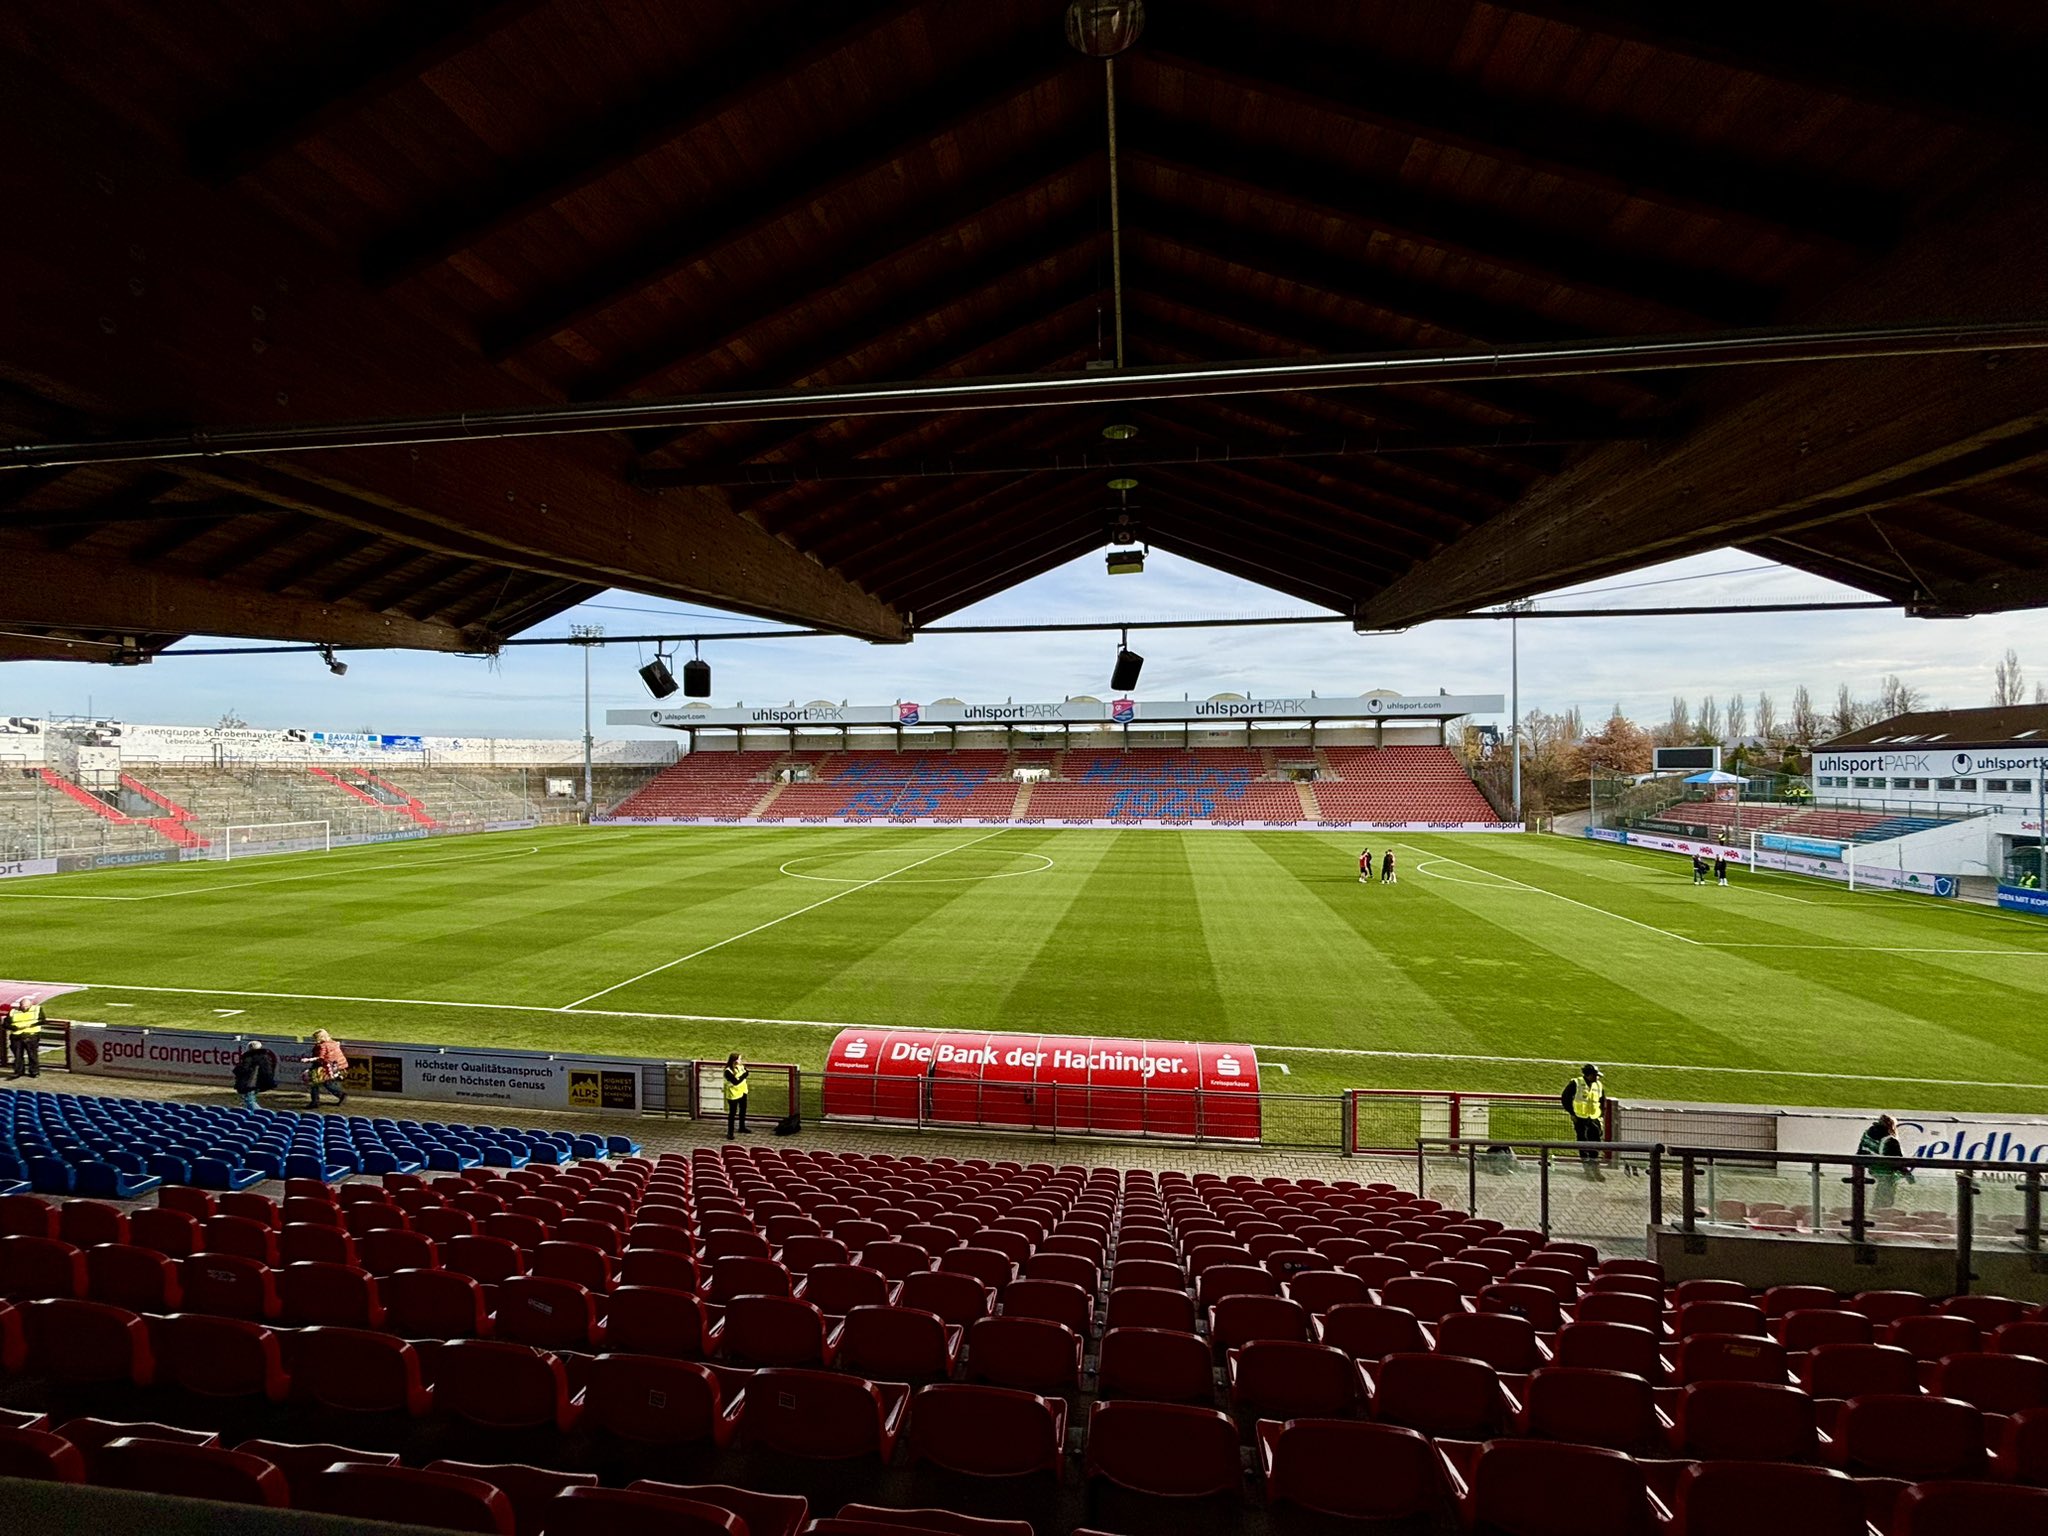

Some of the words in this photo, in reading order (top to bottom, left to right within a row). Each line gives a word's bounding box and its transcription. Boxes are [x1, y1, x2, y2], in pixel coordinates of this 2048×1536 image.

[964, 704, 1063, 721] uhlsportPARK
[1195, 700, 1306, 717] uhlsportPARK
[1386, 702, 1441, 711] uhlsport.com
[664, 713, 706, 721] uhlsport.com
[752, 708, 844, 723] uhlsportPARK
[1819, 755, 1930, 774] uhlsportPARK
[1105, 788, 1217, 817] 1925
[2021, 821, 2043, 830] Seit
[96, 851, 166, 866] clickservice
[2030, 898, 2048, 907] KOP
[102, 1039, 144, 1062] good
[150, 1044, 244, 1066] connected
[891, 1042, 931, 1062] Die
[937, 1043, 1000, 1065] Bank
[1005, 1048, 1048, 1067] der
[1053, 1049, 1188, 1078] Hachinger.
[415, 1059, 458, 1070] Höchster
[461, 1062, 553, 1078] Qualitätsanspruch
[422, 1073, 436, 1082] für
[438, 1074, 458, 1084] den
[460, 1075, 506, 1088] höchsten
[509, 1079, 545, 1090] Genuss
[603, 1084, 632, 1092] QUALITY
[571, 1088, 599, 1098] ALPS
